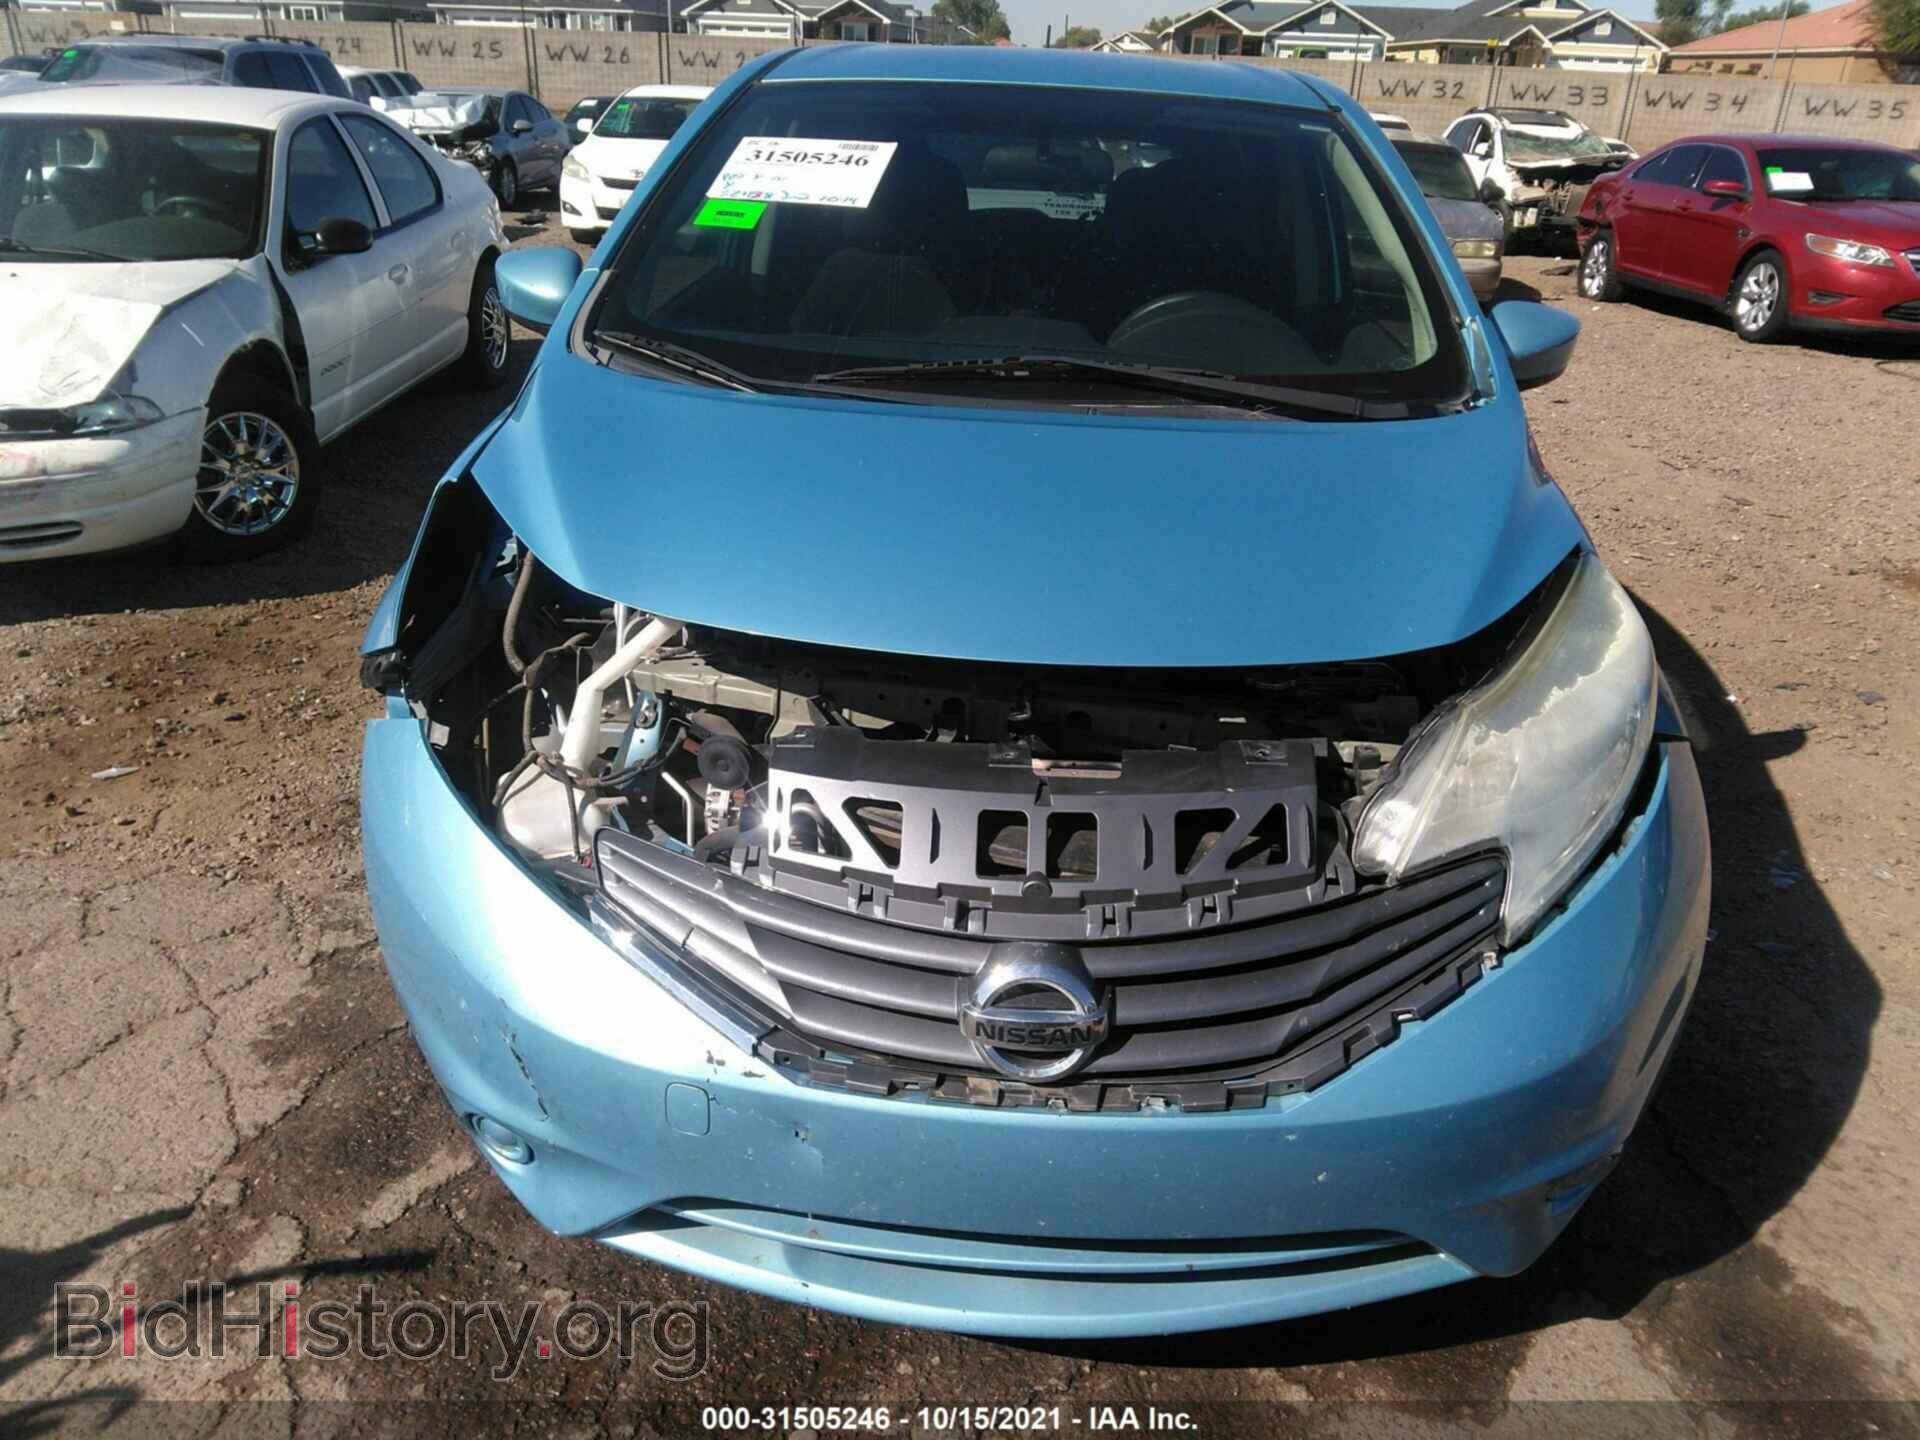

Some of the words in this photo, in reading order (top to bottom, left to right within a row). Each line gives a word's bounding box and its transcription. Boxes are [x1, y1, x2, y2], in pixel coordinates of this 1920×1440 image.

[27, 27, 70, 43] WW
[336, 38, 362, 55] 24
[412, 39, 457, 58] WW
[472, 41, 503, 59] 25
[545, 44, 589, 62] WW
[603, 46, 631, 64] 26
[679, 50, 721, 68] WW
[1378, 79, 1424, 98] WW
[1433, 79, 1465, 100] 32
[1511, 84, 1555, 102] WW
[1567, 85, 1609, 106] 33
[1644, 89, 1693, 110] WW
[1704, 92, 1748, 113] 34
[1805, 98, 1857, 117] WW
[1867, 100, 1908, 120] 35
[745, 149, 870, 167] 31505246
[975, 1021, 1092, 1046] NISSAN
